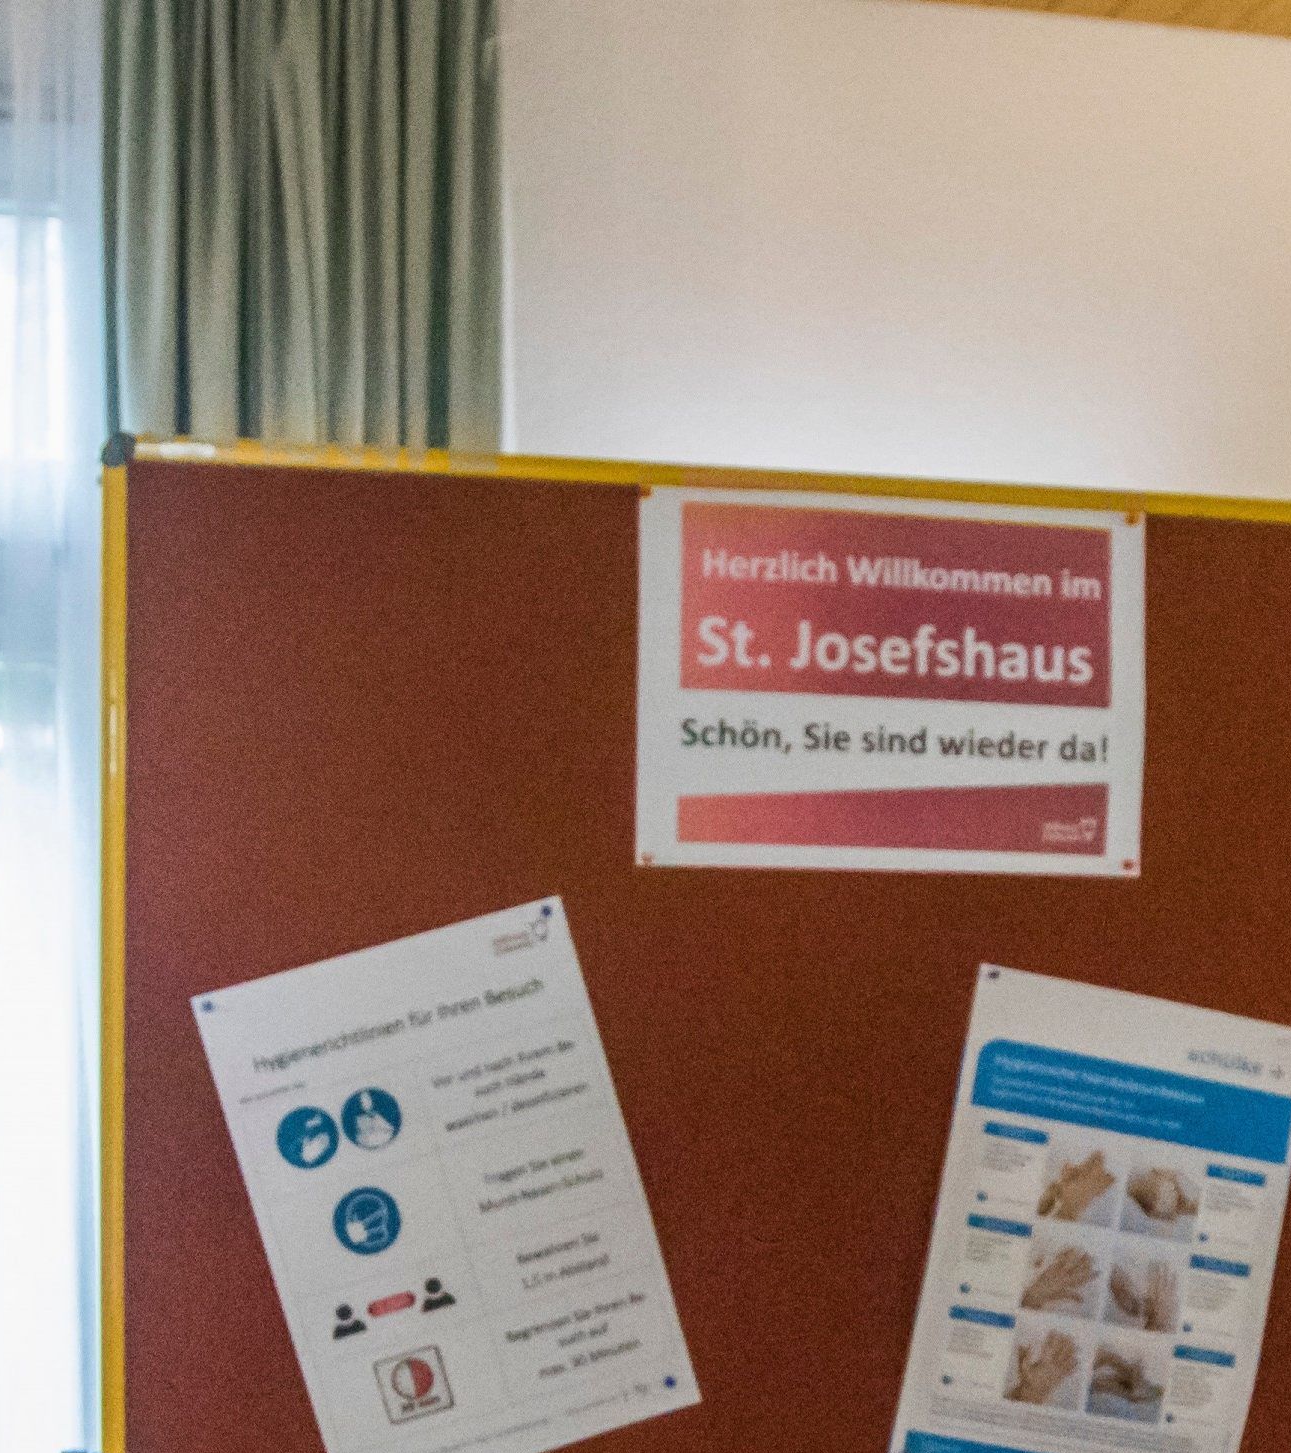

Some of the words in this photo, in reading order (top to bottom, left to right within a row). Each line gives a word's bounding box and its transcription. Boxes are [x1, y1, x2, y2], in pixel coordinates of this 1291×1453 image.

[702, 549, 837, 585] Herzlich
[846, 554, 1051, 597] Willkommen
[1062, 570, 1102, 600] im
[696, 616, 771, 668] St.
[790, 620, 1094, 685] Josefshaus
[681, 718, 792, 755] Schön,
[804, 723, 851, 753] Sie
[863, 725, 928, 756] sind
[939, 729, 1048, 761] wieder
[1059, 735, 1109, 764] da!
[252, 1017, 404, 1074] Hygienerichtlinien
[407, 1008, 433, 1027] für
[437, 995, 481, 1018] Ihren
[484, 978, 543, 1005] Besuch
